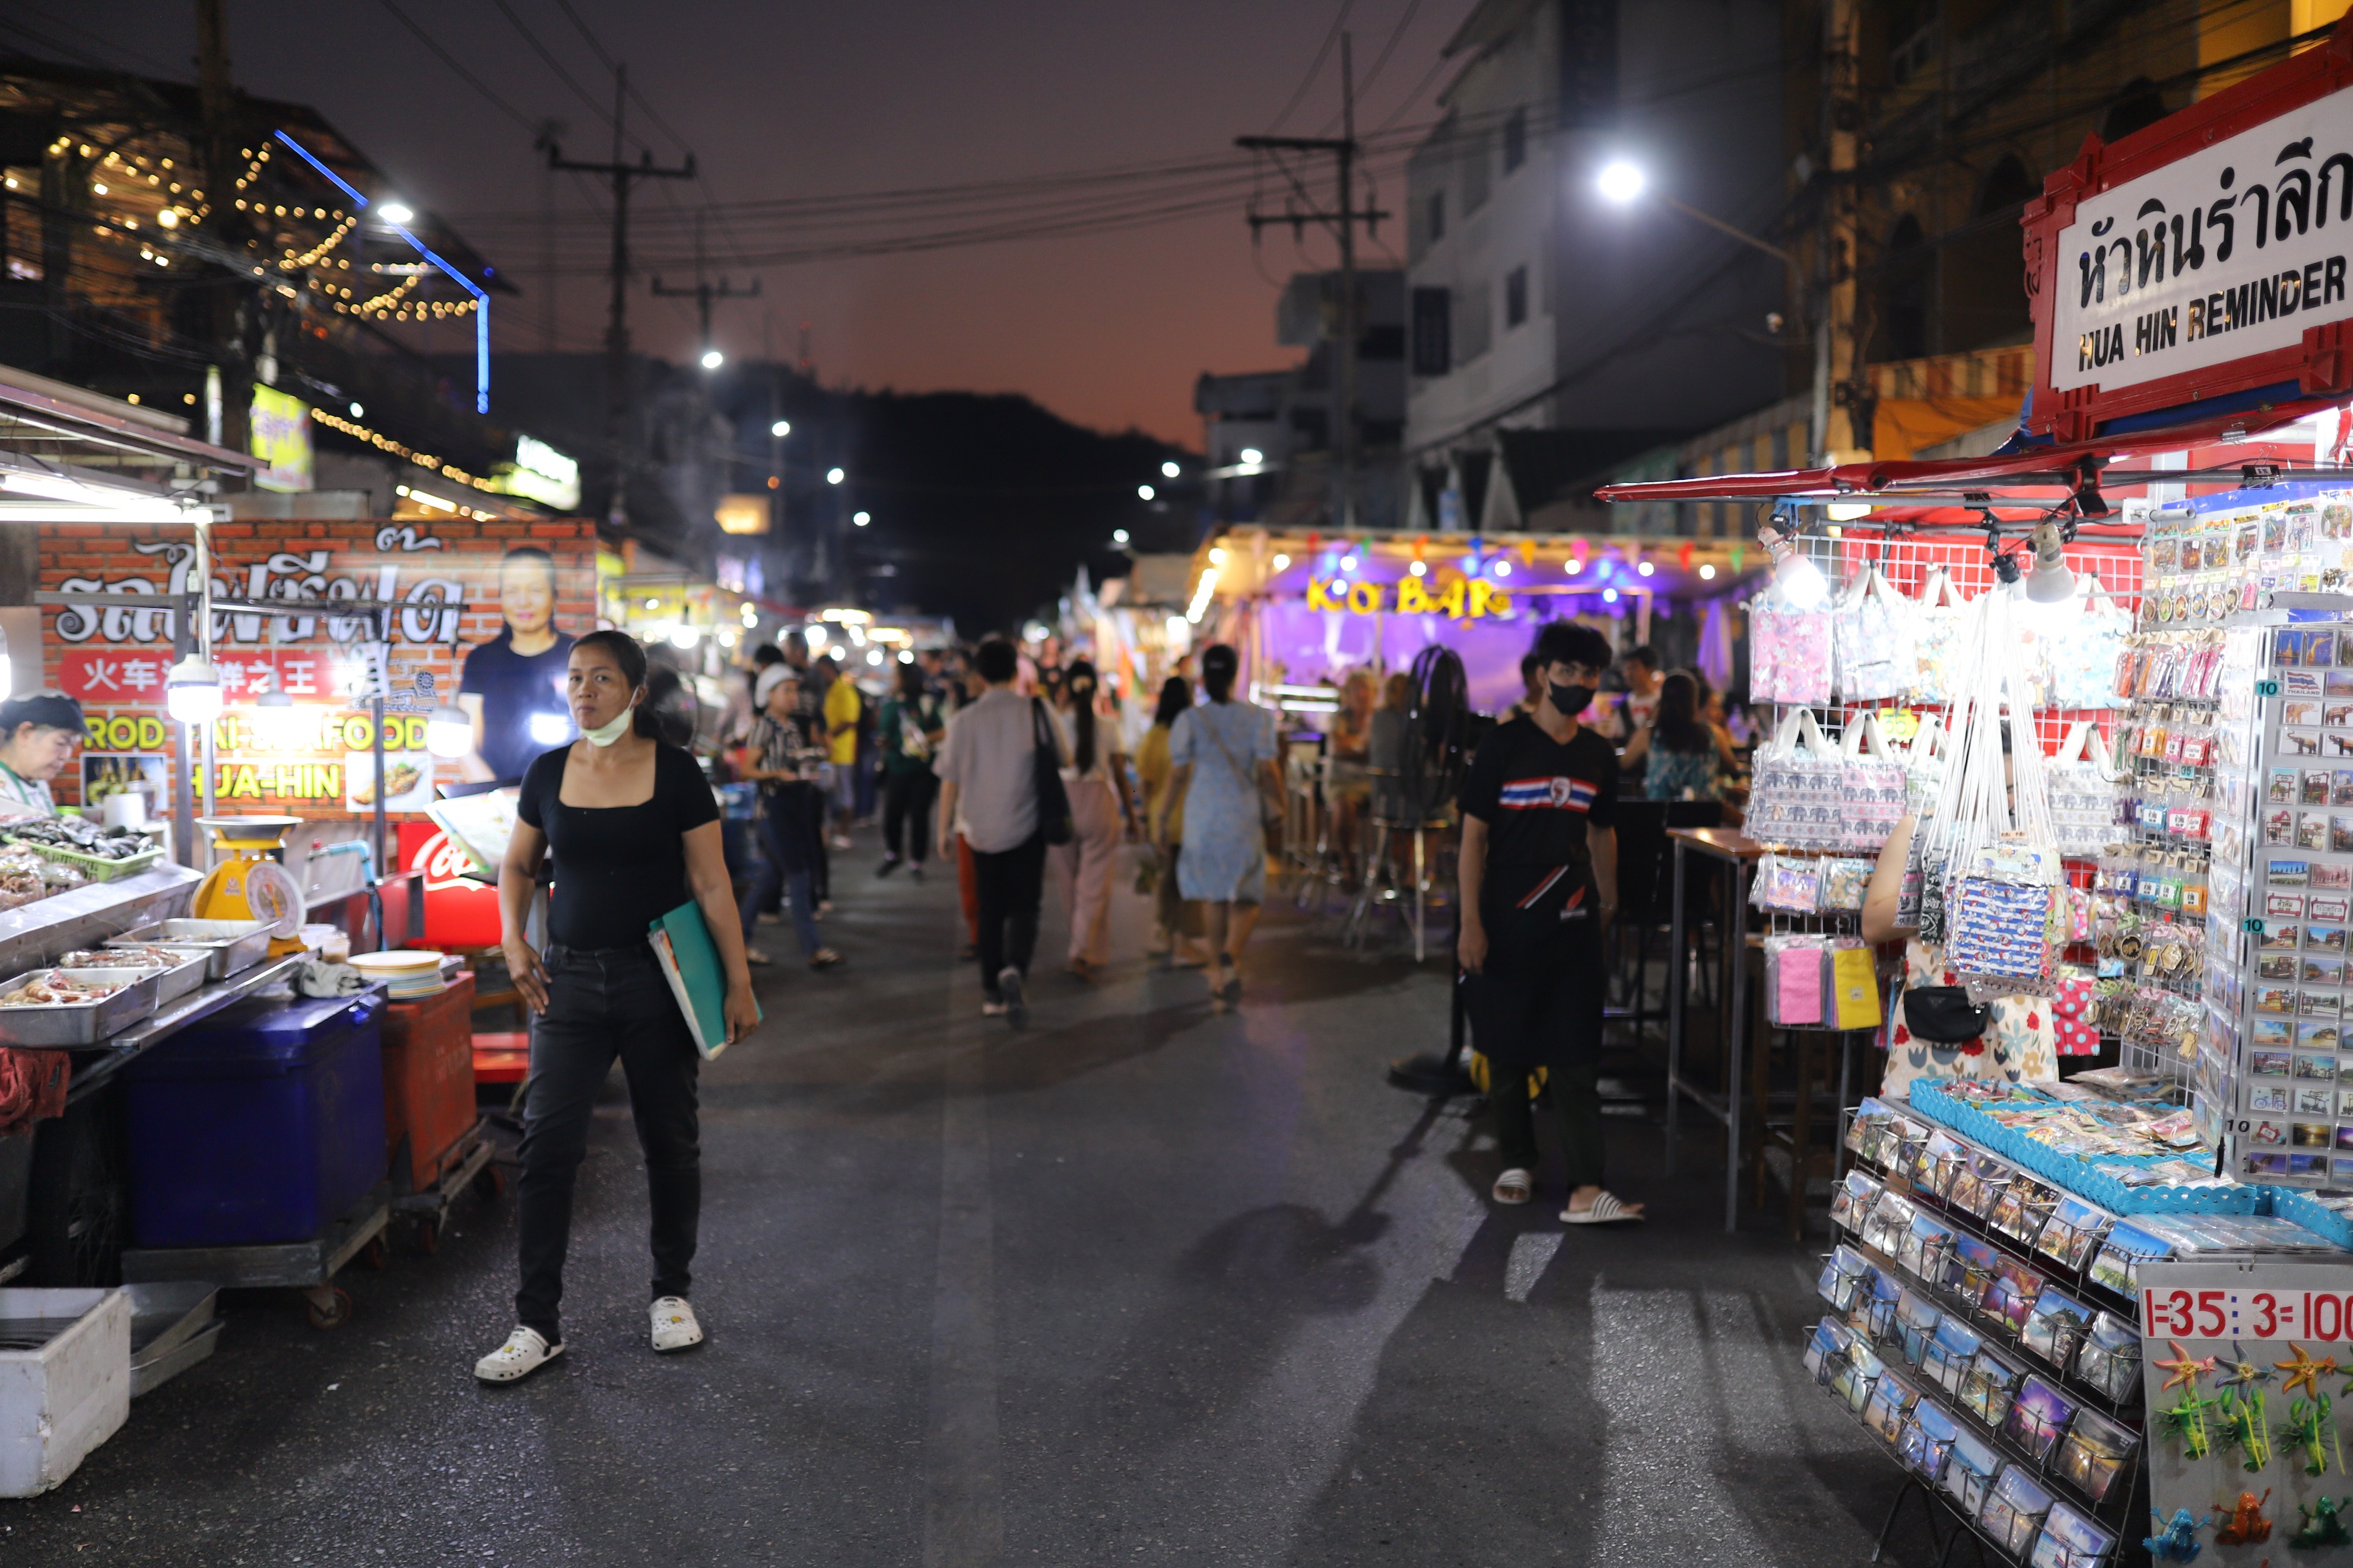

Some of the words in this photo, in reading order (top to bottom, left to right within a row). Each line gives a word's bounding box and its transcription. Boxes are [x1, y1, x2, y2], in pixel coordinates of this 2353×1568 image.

[2079, 136, 2353, 308] หัวหินรำลึก
[2078, 323, 2125, 372] HUA
[2135, 306, 2177, 357] HIN
[2187, 255, 2346, 343] REMINDER
[1396, 574, 1513, 621] BAR
[82, 657, 318, 695] 火车鲜之王
[2259, 682, 2278, 696] 10
[82, 715, 166, 750] ROD
[2181, 765, 2192, 775] 35
[2245, 919, 2263, 932] 10
[2227, 1119, 2250, 1133] 10
